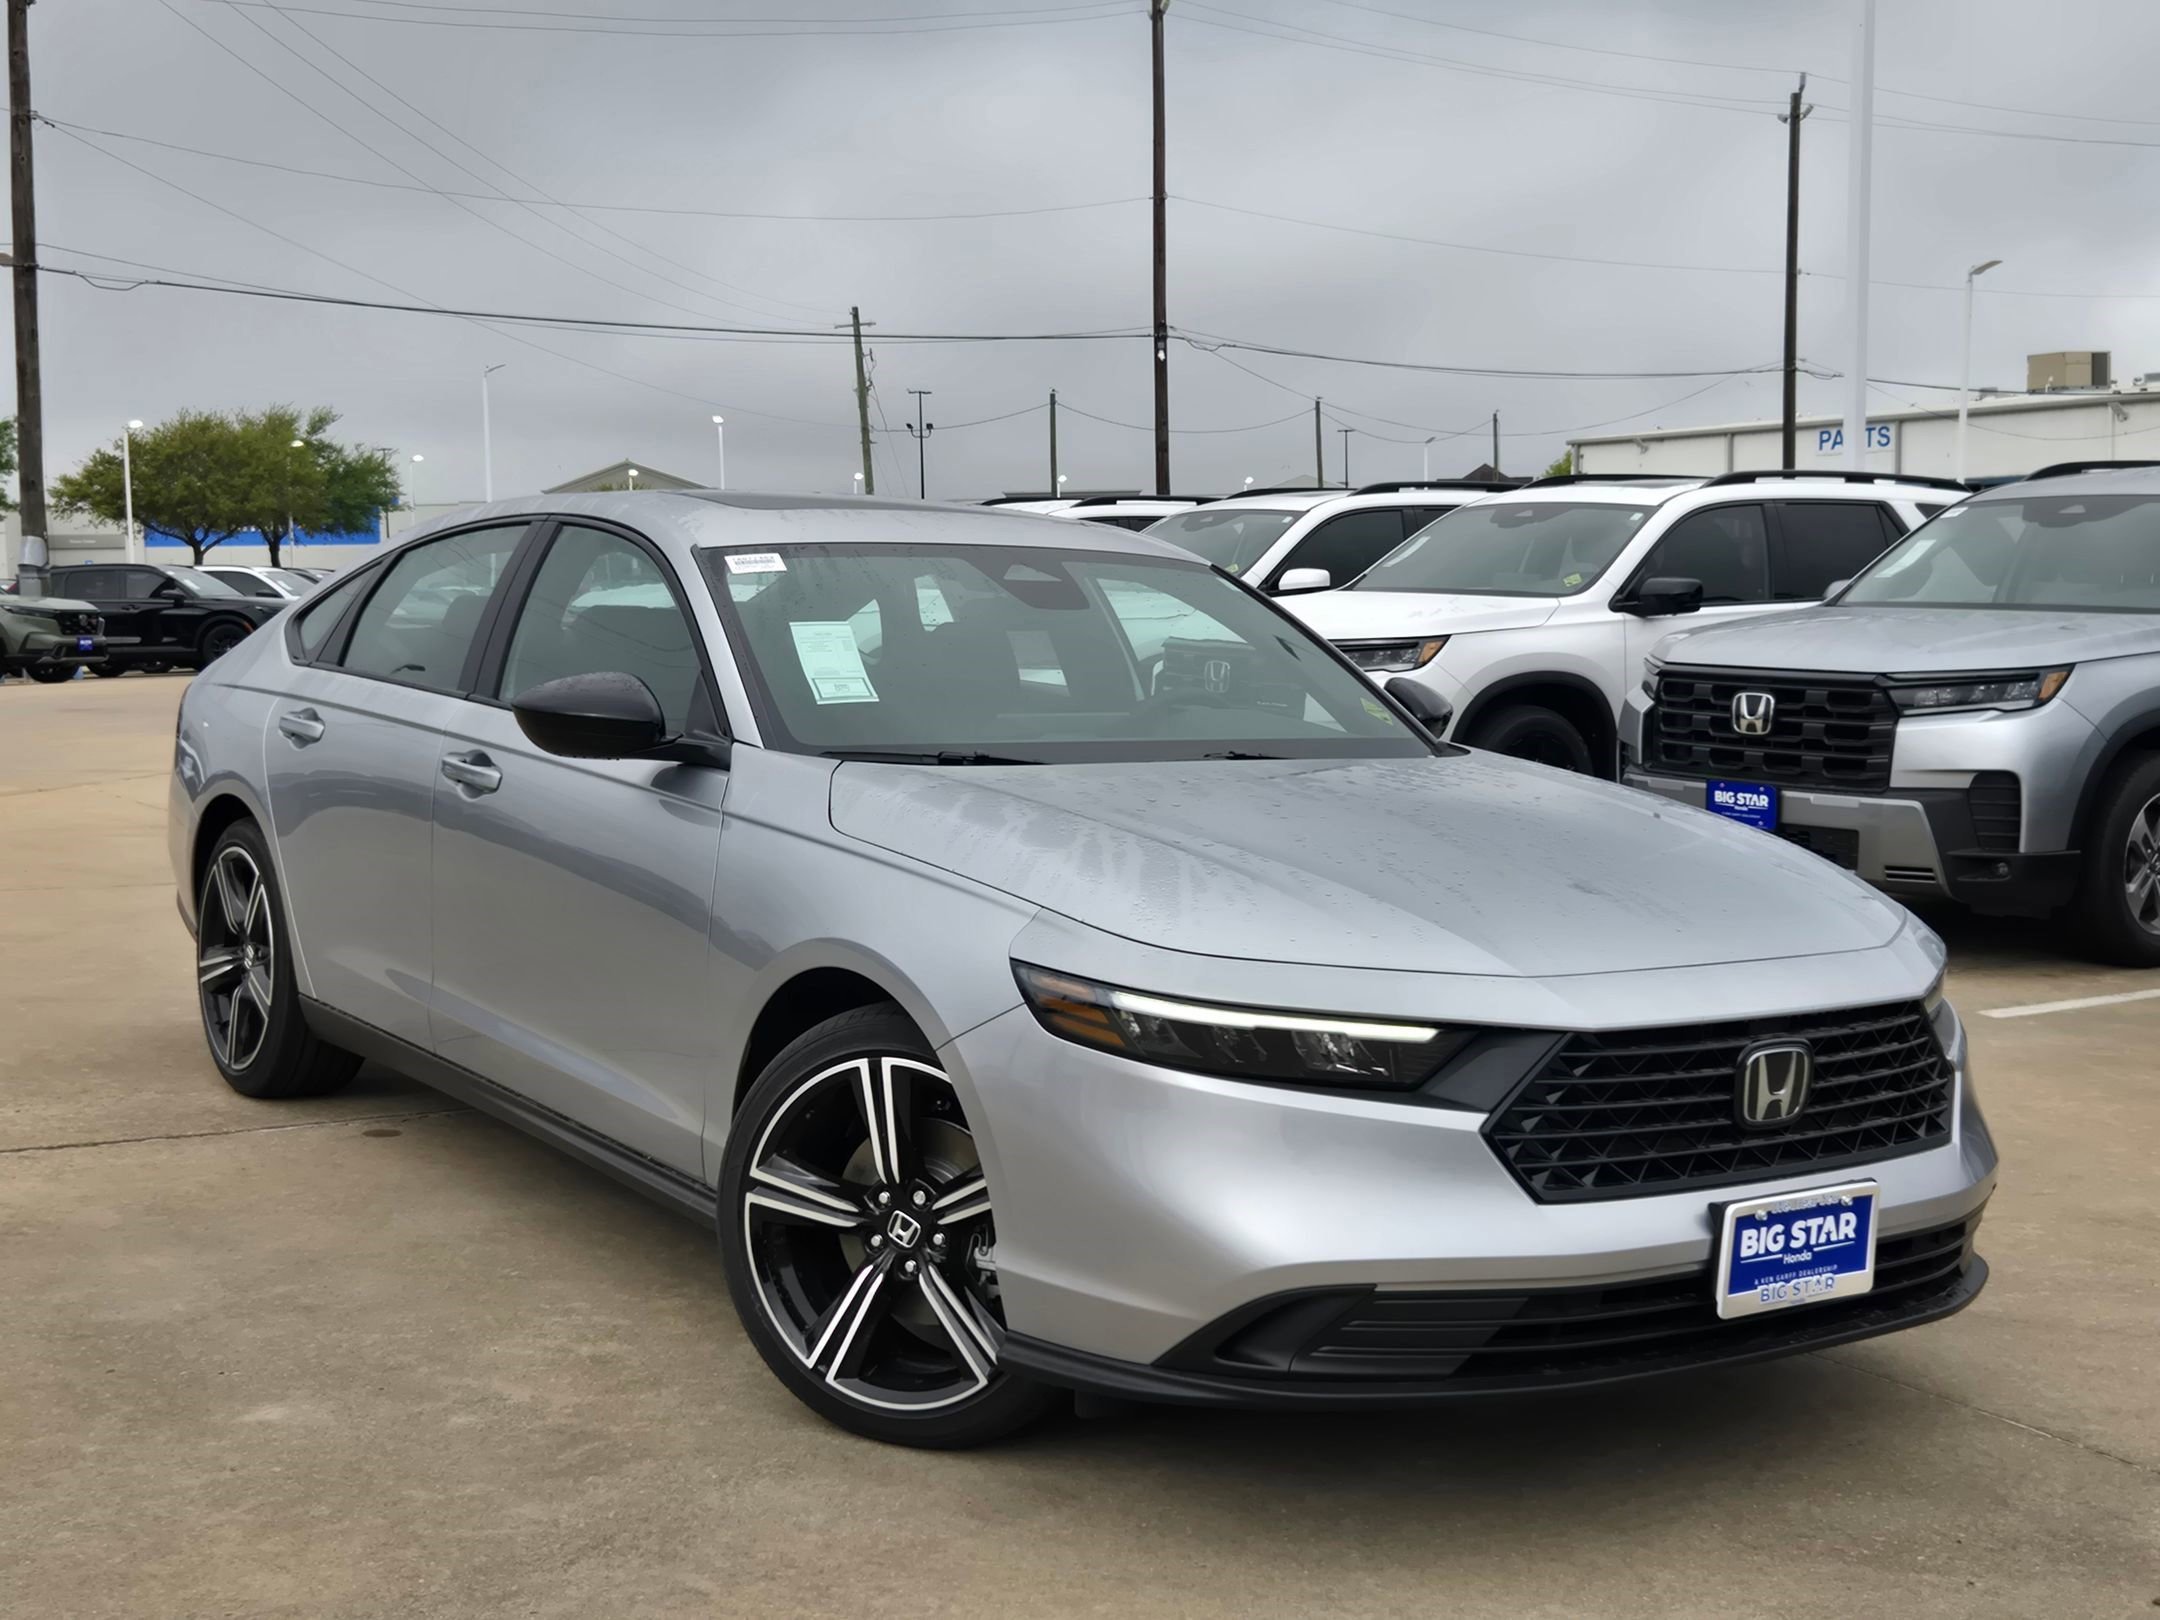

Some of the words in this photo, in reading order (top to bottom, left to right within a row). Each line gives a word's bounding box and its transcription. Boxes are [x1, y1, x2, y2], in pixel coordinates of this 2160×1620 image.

[1819, 426, 1891, 451] PATS
[1714, 790, 1735, 804] BIG
[1736, 792, 1769, 808] STAR
[1740, 1224, 1785, 1258] BIG
[1789, 1212, 1856, 1248] STAR
[1783, 1251, 1813, 1265] Honda
[1760, 1284, 1787, 1302] BIG
[1792, 1276, 1835, 1296] STAR
